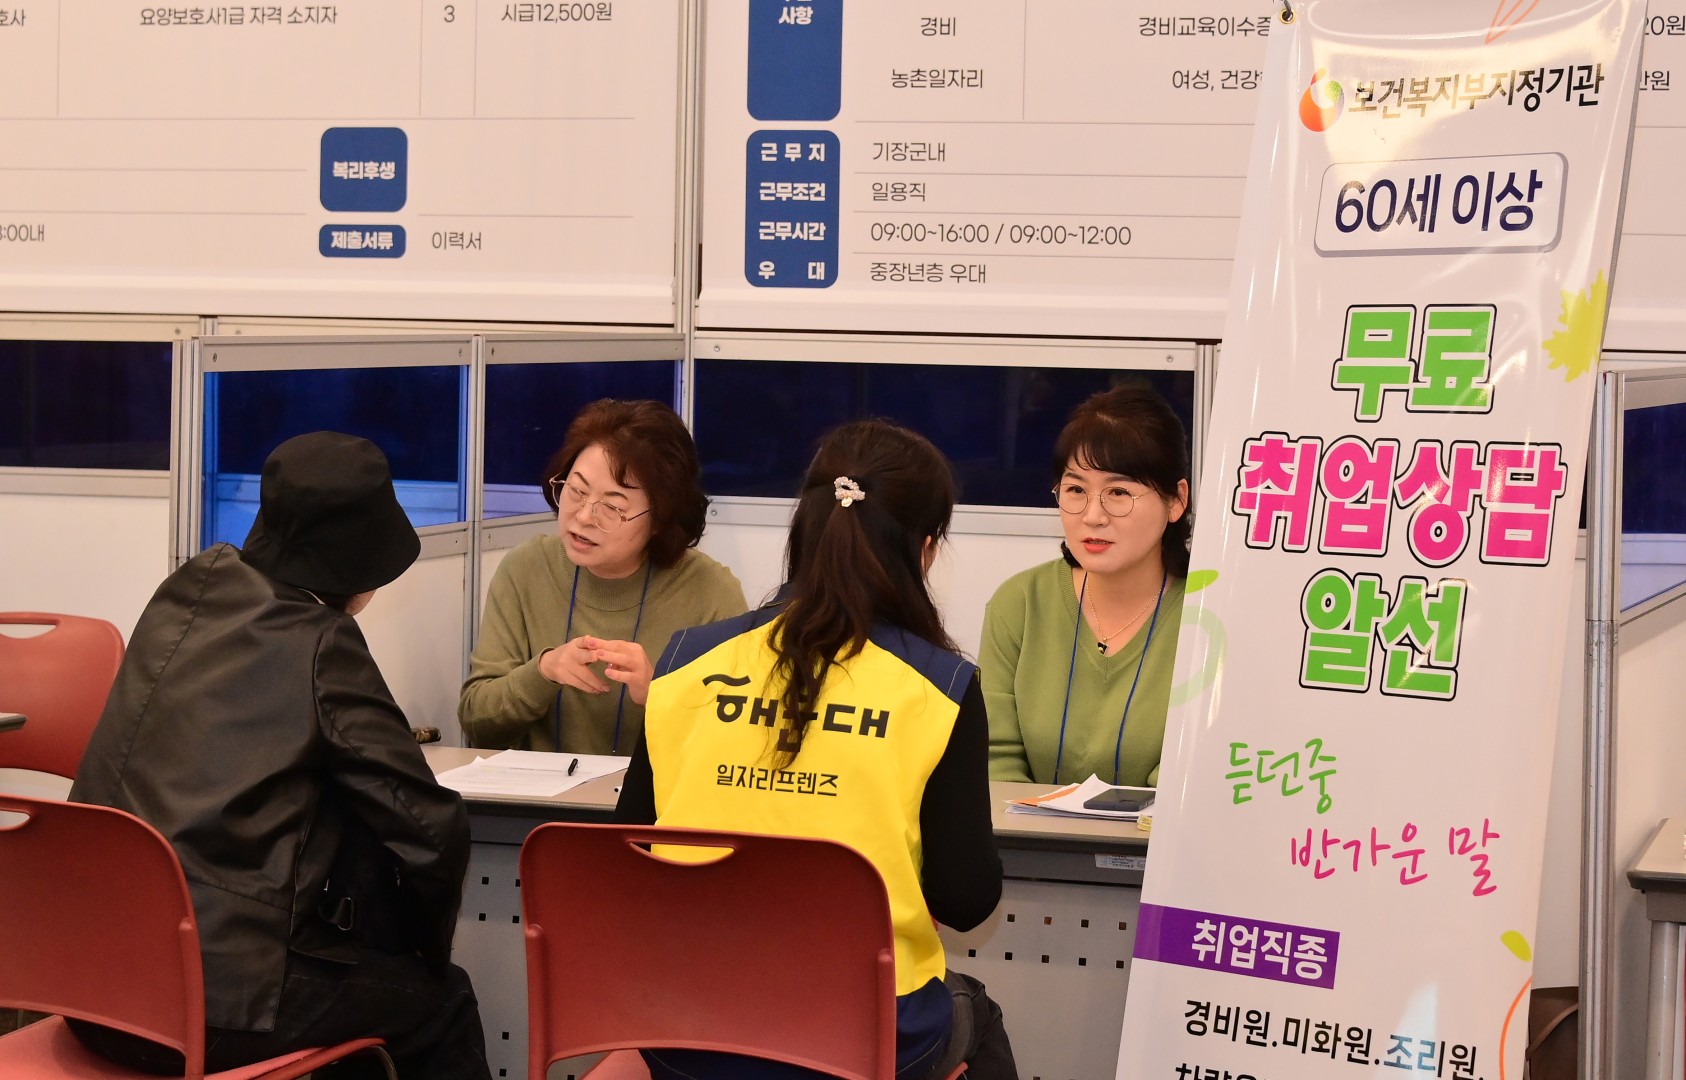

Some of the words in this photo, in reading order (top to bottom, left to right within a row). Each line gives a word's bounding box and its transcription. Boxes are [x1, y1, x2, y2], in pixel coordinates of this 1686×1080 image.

[140, 8, 245, 26] 요양보호사1급
[250, 7, 283, 25] 자격
[287, 6, 338, 25] 소지자
[444, 5, 455, 23] 3
[501, 3, 613, 23] 시급12,500원
[778, 6, 814, 25] 사항
[920, 17, 957, 37] 경비
[890, 69, 984, 90] 농촌일자리
[1172, 69, 1215, 91] 여성,
[1220, 69, 1263, 90] 건강
[1348, 62, 1605, 120] 보건복지부지정기관
[871, 142, 946, 163] 기장군내
[332, 160, 396, 181] 복리후생
[759, 182, 826, 202] 근무조건
[871, 182, 926, 203] 일용직
[1334, 173, 1442, 234] 60세
[1451, 169, 1543, 232] 이상
[0, 223, 45, 242] :00내
[330, 230, 394, 252] 제출서류
[431, 231, 482, 252] 이력서
[758, 221, 826, 242] 근무시간
[870, 223, 989, 244] 09:00~16:00
[994, 223, 1004, 245] /
[1009, 226, 1132, 246] 09:00~12:00
[870, 262, 944, 283] 중장년층
[949, 263, 986, 284] 우대
[1331, 304, 1497, 422] 무료
[1231, 431, 1568, 567] 취업상담
[1299, 567, 1468, 701] 알선
[716, 764, 839, 797] 일자리프렌즈
[1225, 738, 1337, 814] 듣던중
[1291, 822, 1428, 886] 반가운
[1448, 818, 1501, 896] 말
[1191, 919, 1328, 981] 취업직종
